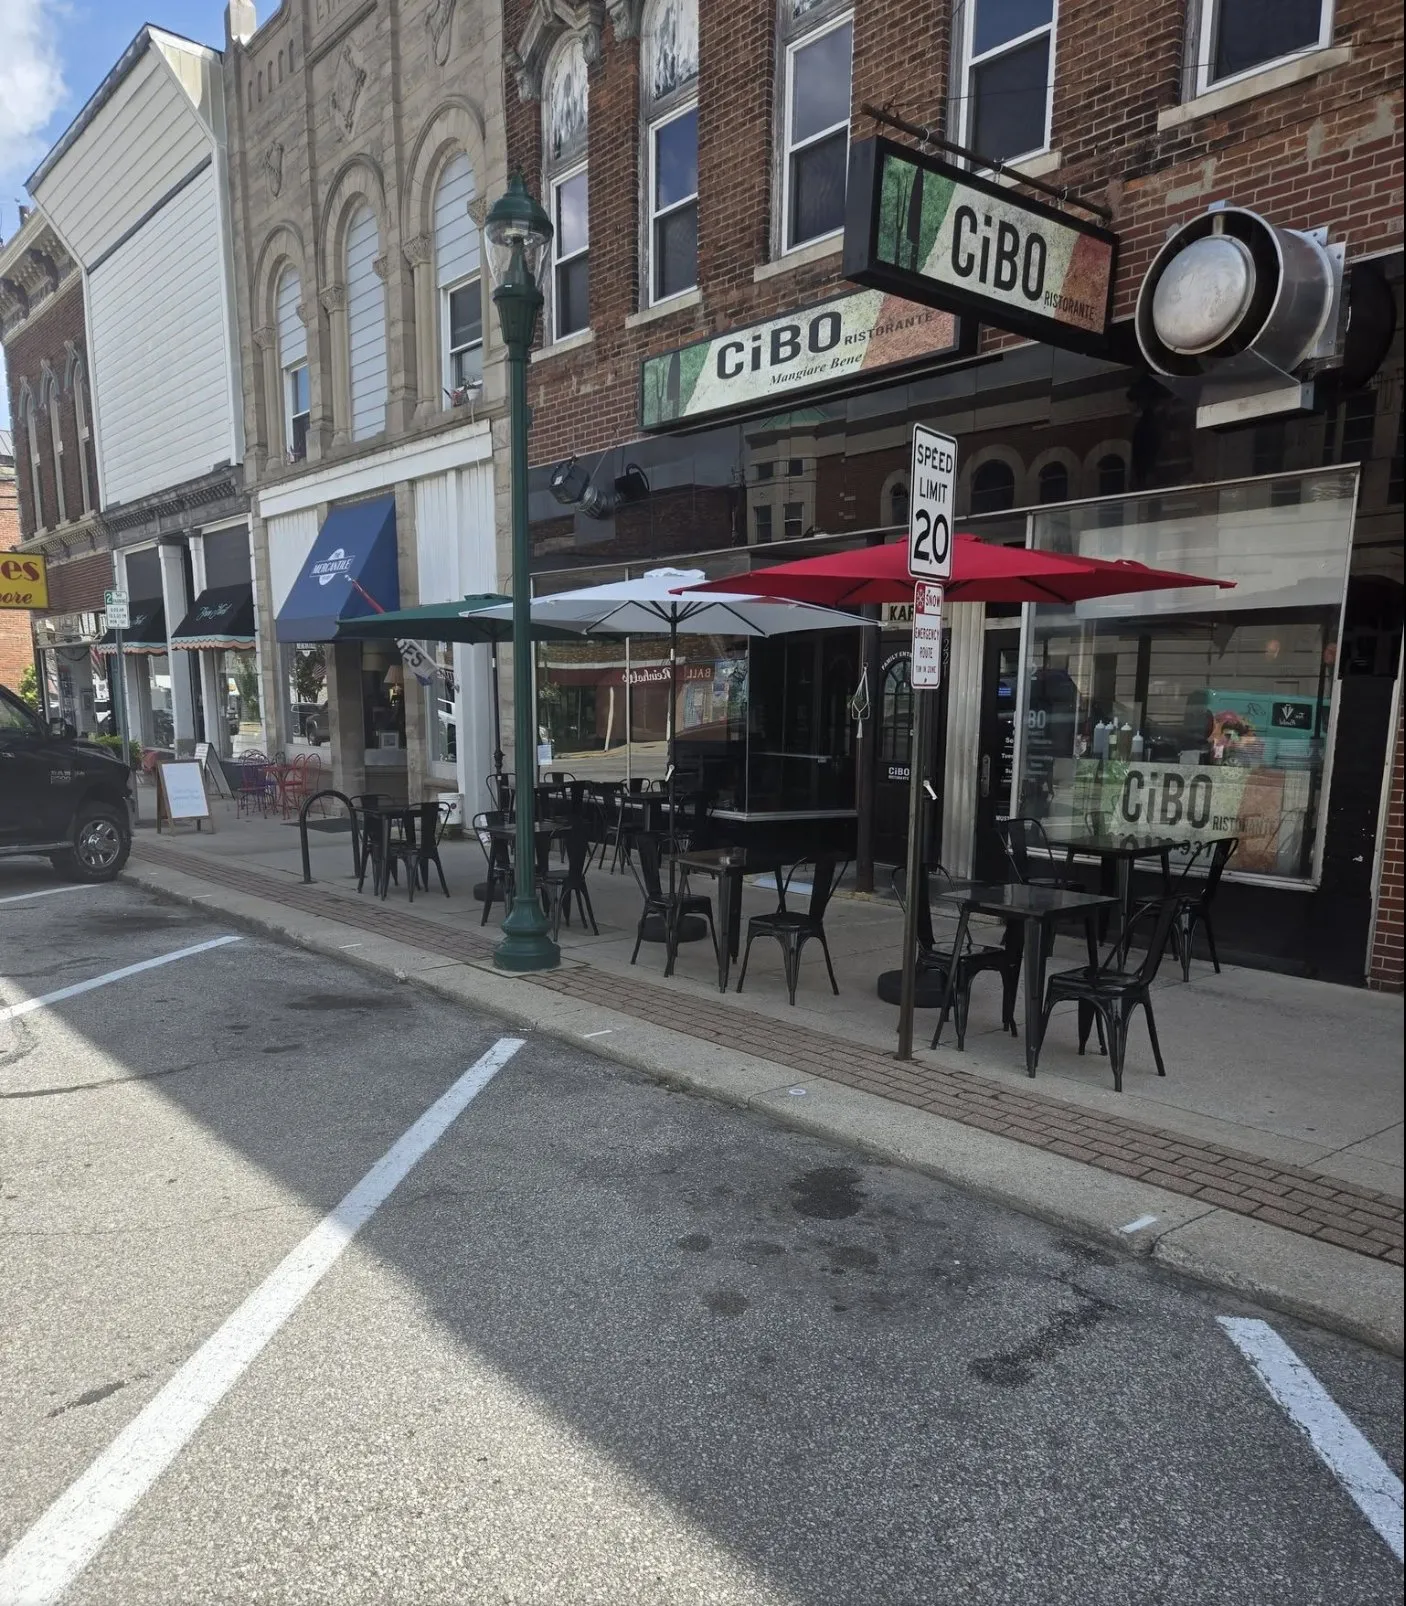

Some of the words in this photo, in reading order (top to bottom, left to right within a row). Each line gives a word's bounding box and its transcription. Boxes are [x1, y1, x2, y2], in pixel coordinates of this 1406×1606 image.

[951, 205, 1047, 301] CiBO
[1043, 291, 1095, 321] RISTORANTE
[717, 311, 842, 380] CiBO
[844, 312, 933, 346] RISTORANTE
[769, 363, 827, 386] Mangiare
[830, 353, 863, 370] Bene
[917, 443, 953, 474] SPEED
[919, 477, 948, 504] LIMIT
[913, 508, 949, 565] 20
[312, 559, 351, 574] MERCANTILE
[0, 592, 32, 604] ore
[105, 593, 112, 604] 2
[925, 594, 941, 608] SNOW
[915, 627, 940, 640] EMERGENCY
[881, 652, 898, 671] FAMILY
[919, 646, 933, 659] ROUTE
[888, 766, 910, 777] CiBO
[1122, 770, 1213, 829] CiBO
